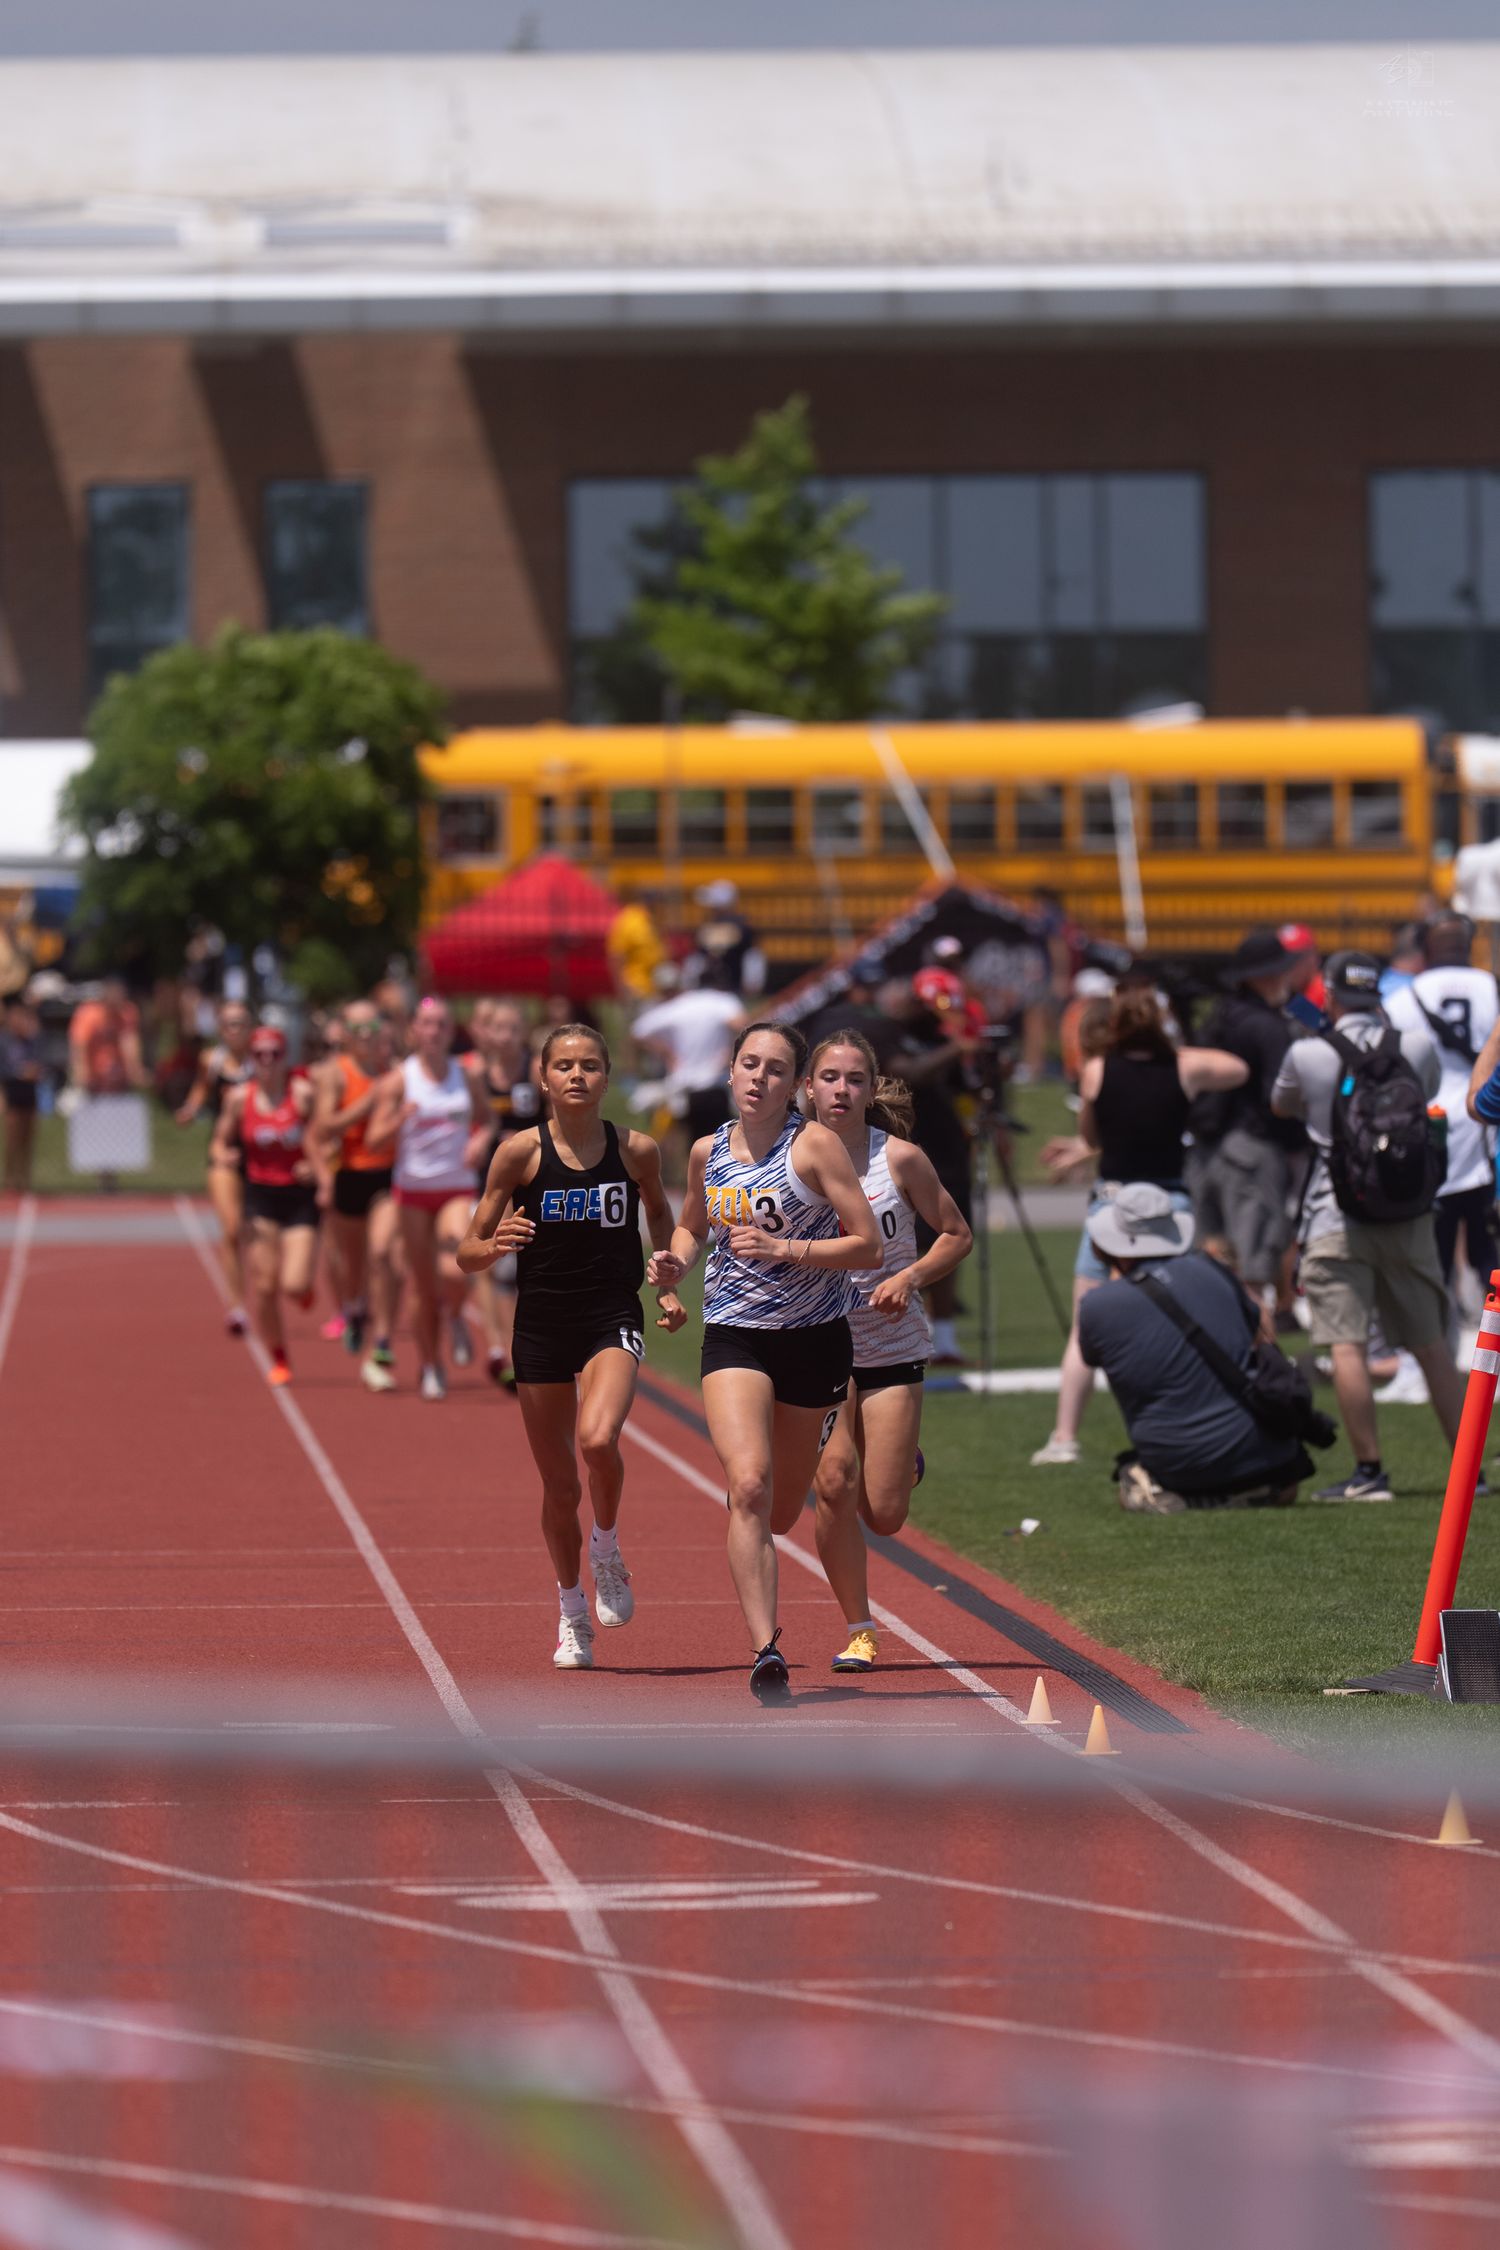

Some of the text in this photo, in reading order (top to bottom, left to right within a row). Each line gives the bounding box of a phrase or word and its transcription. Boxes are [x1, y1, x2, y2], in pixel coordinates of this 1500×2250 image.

[604, 1185, 625, 1225] 6
[755, 1196, 784, 1233] 3
[820, 1410, 838, 1447] 3
